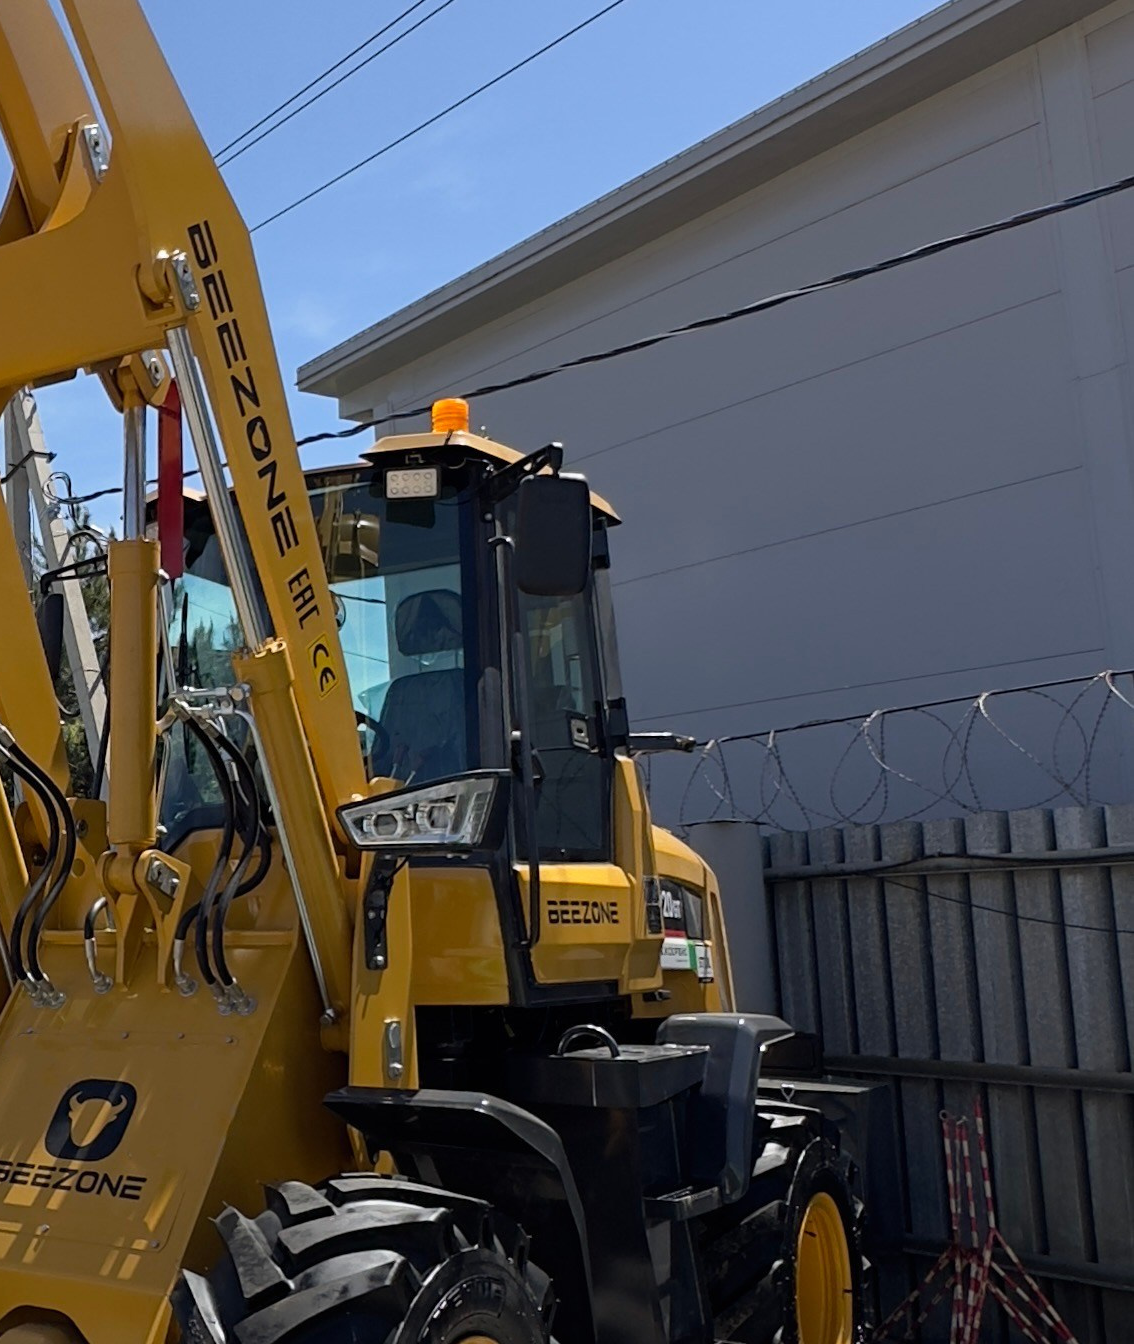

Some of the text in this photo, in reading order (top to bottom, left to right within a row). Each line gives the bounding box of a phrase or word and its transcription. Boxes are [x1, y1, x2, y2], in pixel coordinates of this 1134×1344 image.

[187, 219, 336, 692] BEEZONE EAC CE
[547, 900, 620, 924] BEEZONE
